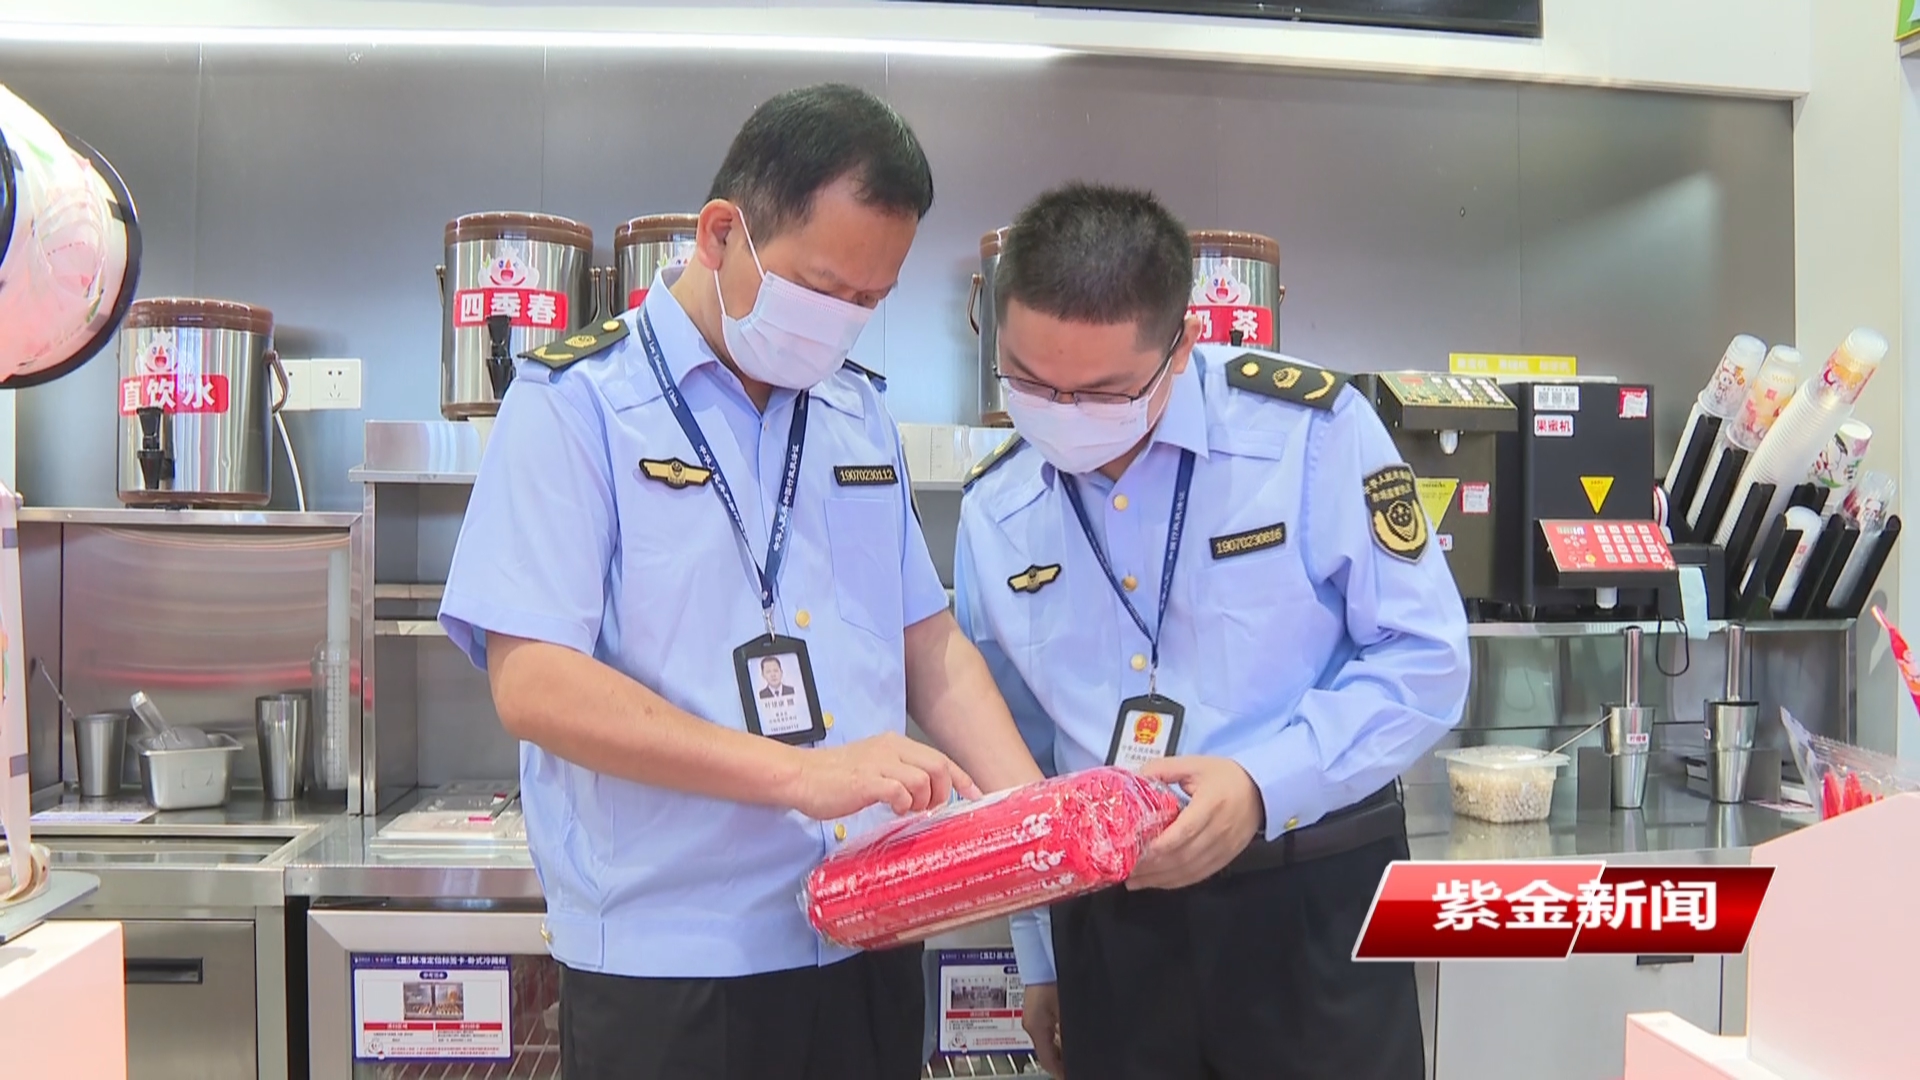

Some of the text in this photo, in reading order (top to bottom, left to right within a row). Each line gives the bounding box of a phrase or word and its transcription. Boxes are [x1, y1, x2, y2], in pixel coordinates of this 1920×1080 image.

[460, 292, 557, 324] 四季春
[122, 375, 215, 410] 直饮水
[839, 468, 894, 482] 19070230112
